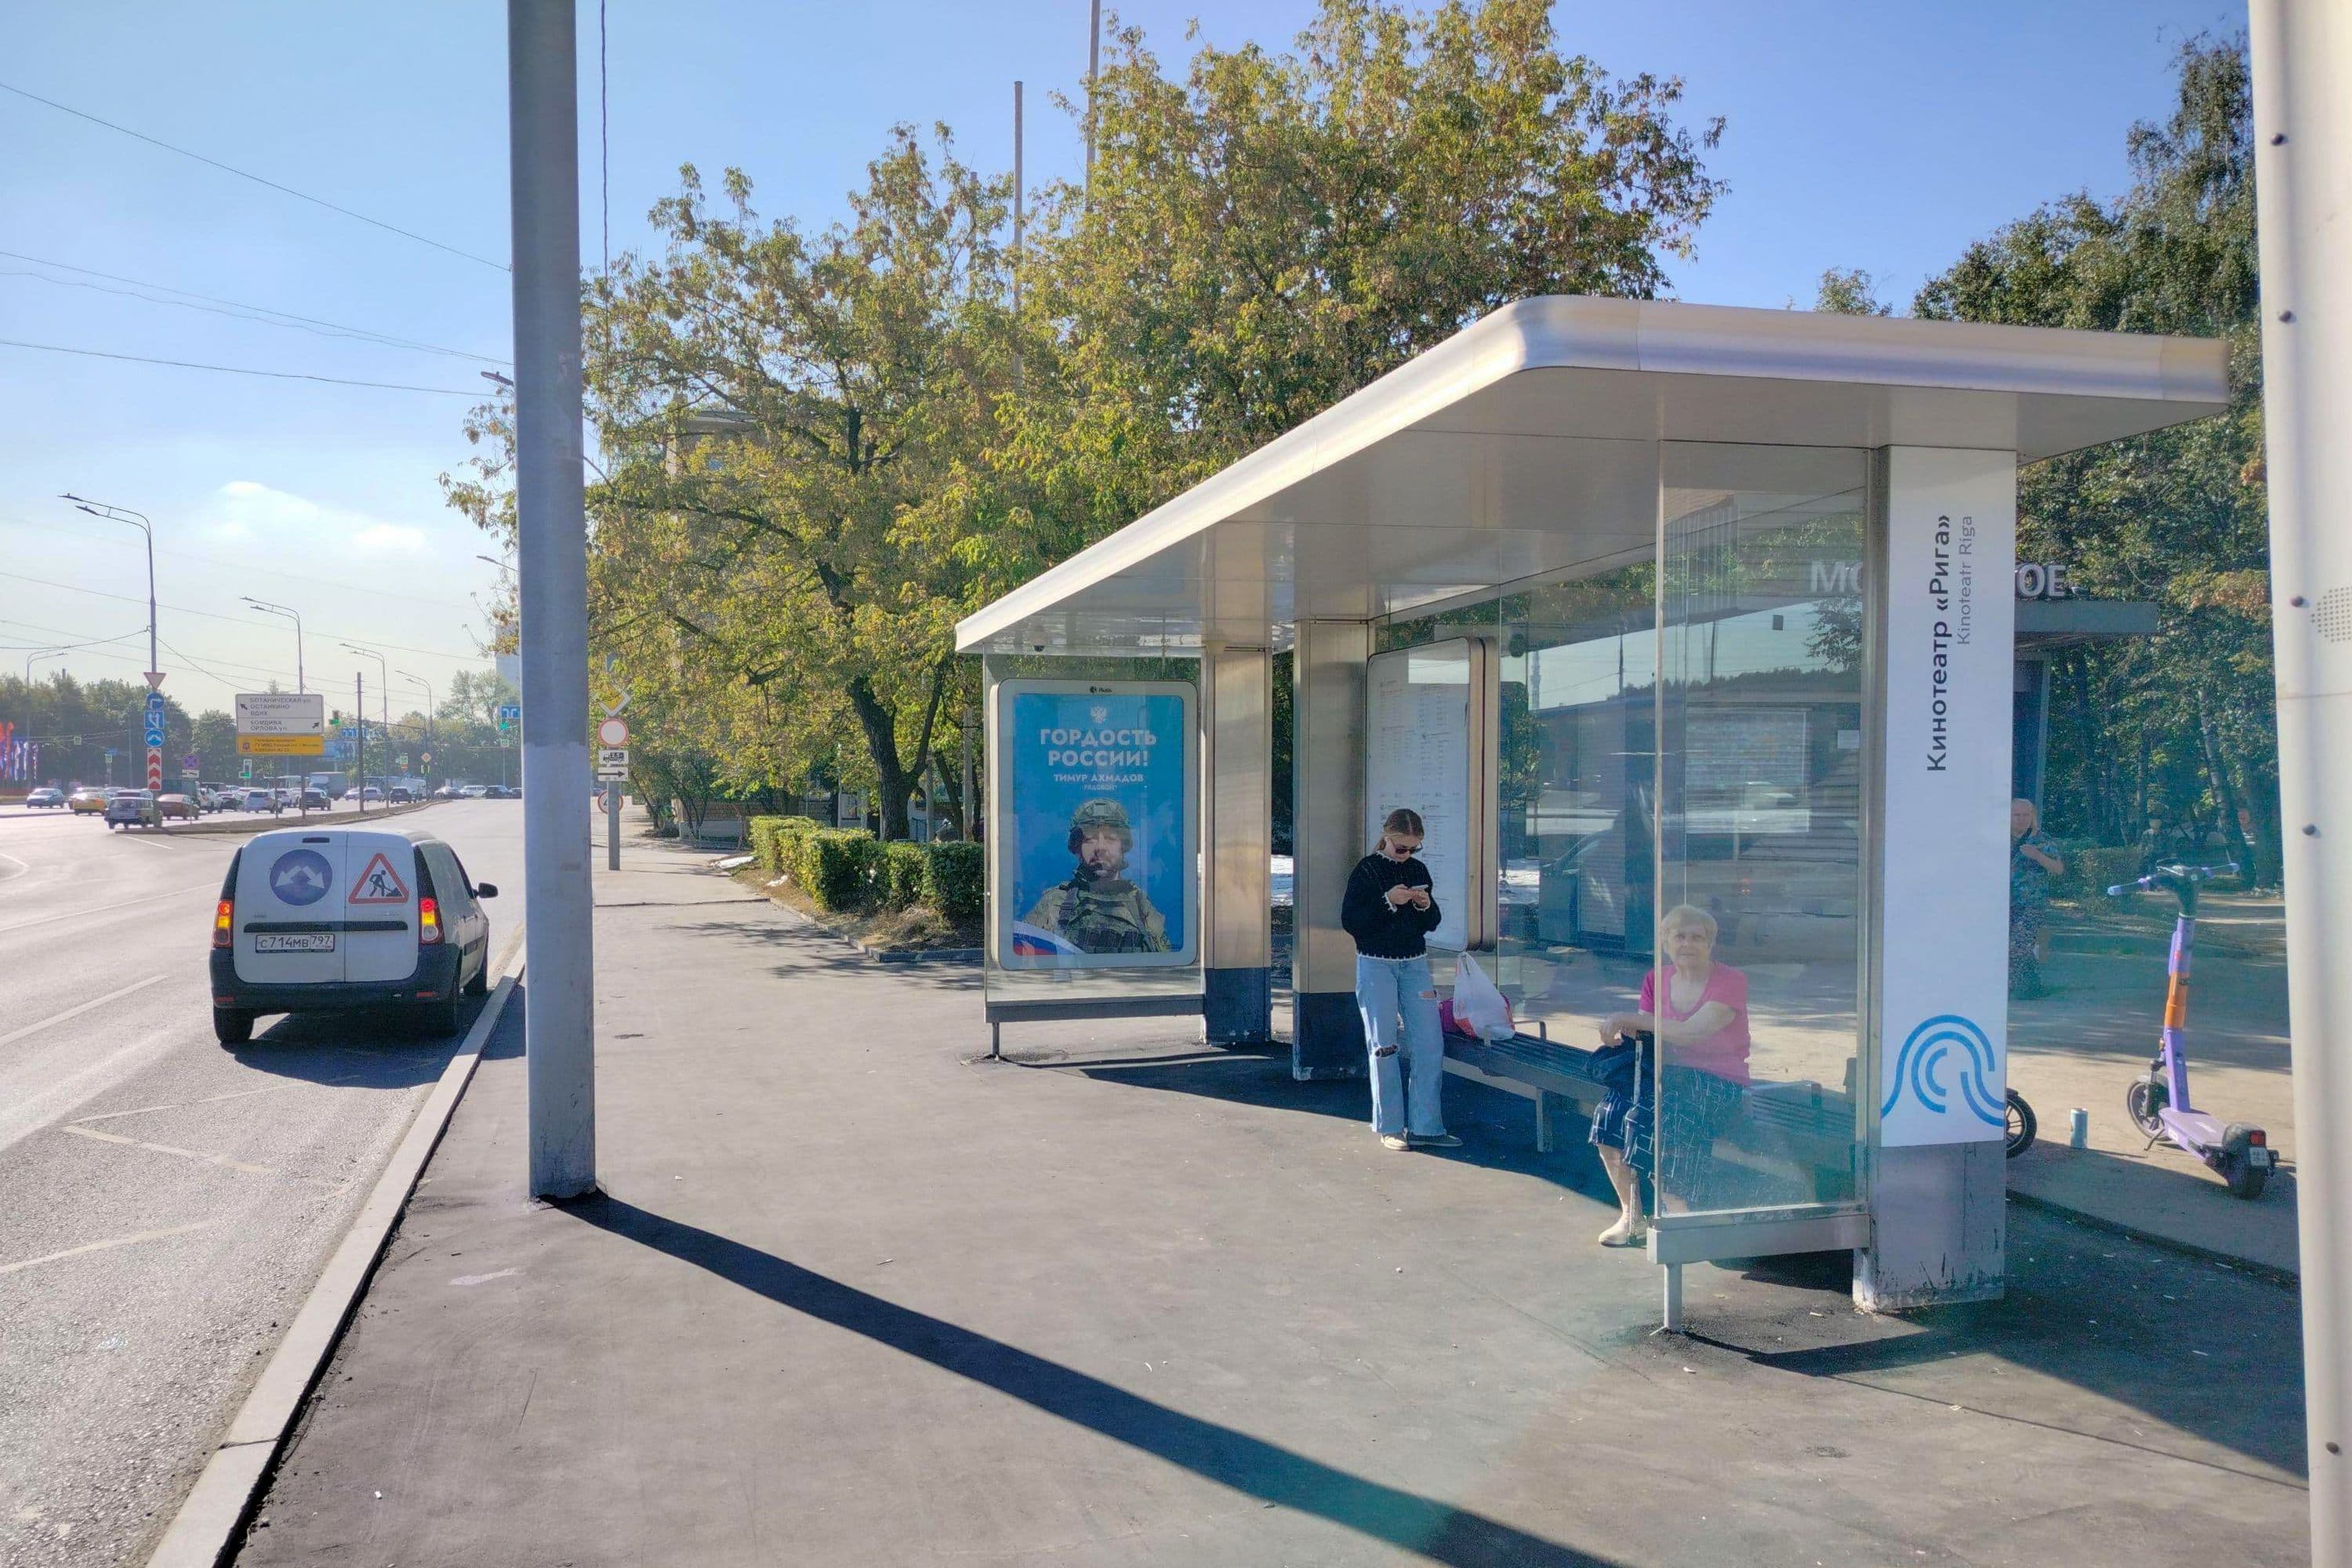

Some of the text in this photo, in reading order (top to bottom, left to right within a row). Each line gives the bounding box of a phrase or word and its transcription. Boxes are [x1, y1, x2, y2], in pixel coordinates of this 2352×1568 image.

[1957, 516, 1975, 644] Kinoteatr Riga
[1926, 514, 1952, 771] Кинотеатр «Рига»
[1040, 728, 1157, 747] ГОРДОСТЬ
[1047, 750, 1149, 767] РОССИИ!
[1054, 773, 1144, 783] ТИМУР АХМАДОВ
